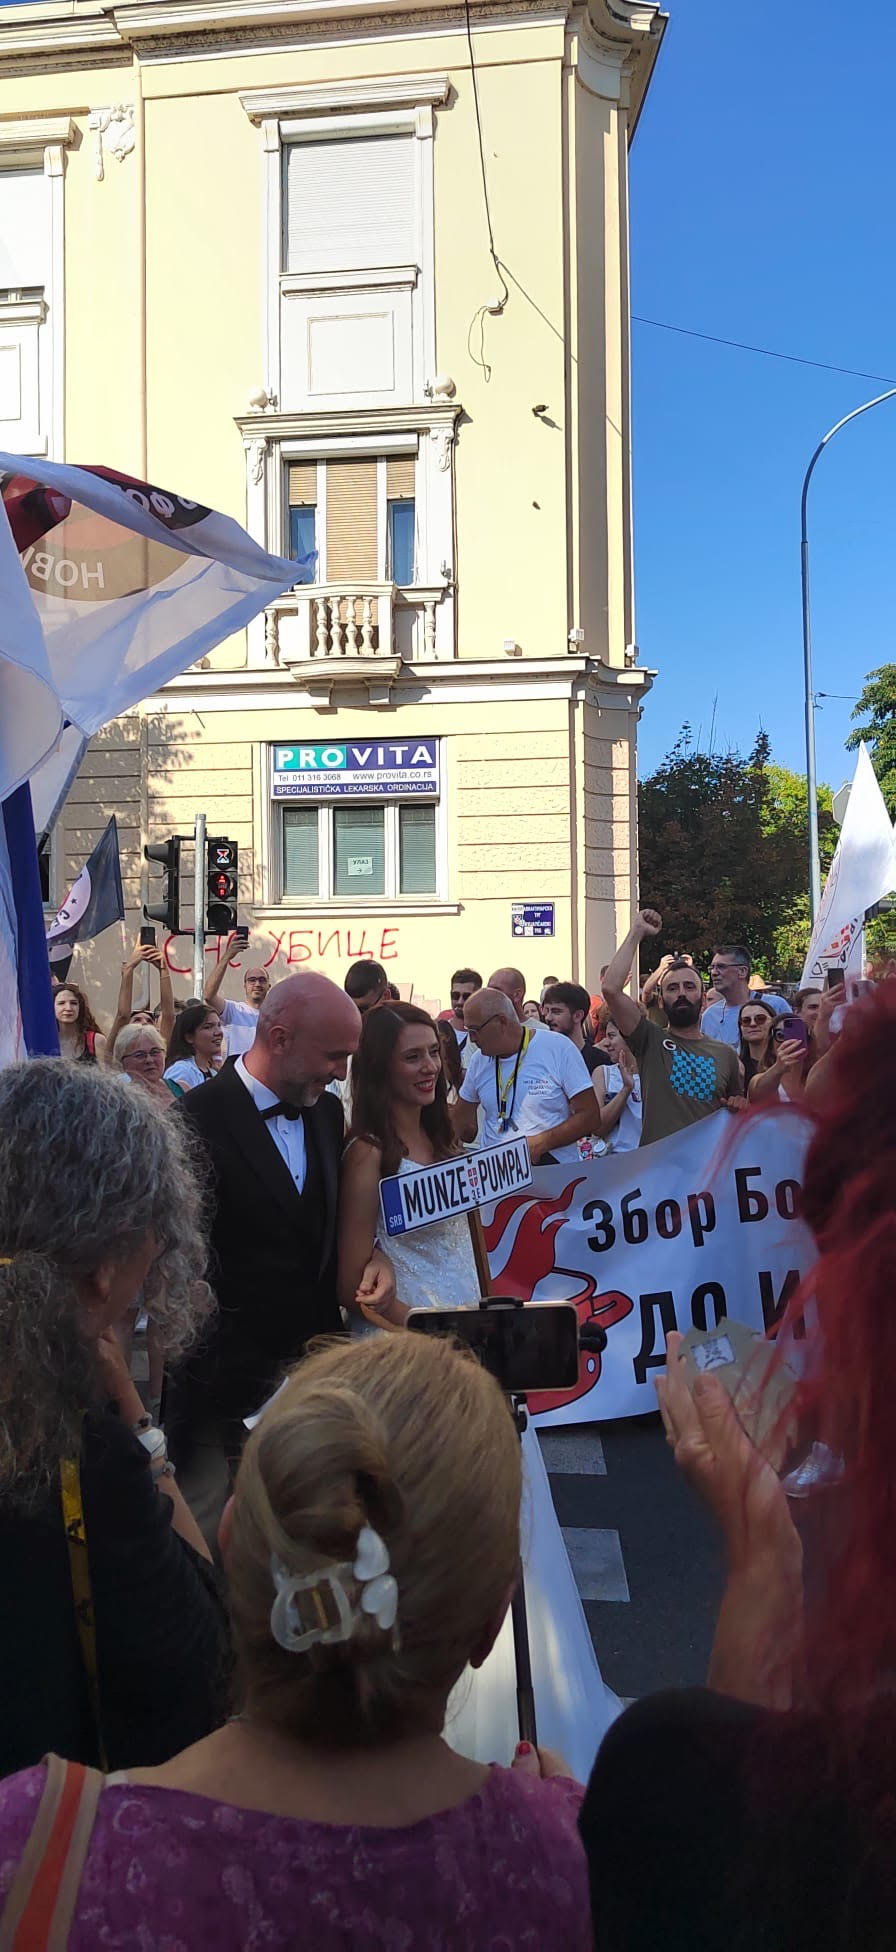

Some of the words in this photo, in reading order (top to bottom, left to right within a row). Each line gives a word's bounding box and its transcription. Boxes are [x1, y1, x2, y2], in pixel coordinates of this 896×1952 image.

[276, 784, 341, 795] SPECIJALISTIČKA
[344, 783, 384, 793] LEKARSKA
[387, 782, 434, 792] ORDINACIJA
[264, 928, 400, 967] УБИЦЕ
[403, 1165, 470, 1222] MUNZE
[477, 1143, 530, 1197] PUMPAJ
[389, 1213, 404, 1228] SRB
[582, 1187, 717, 1253] Збор
